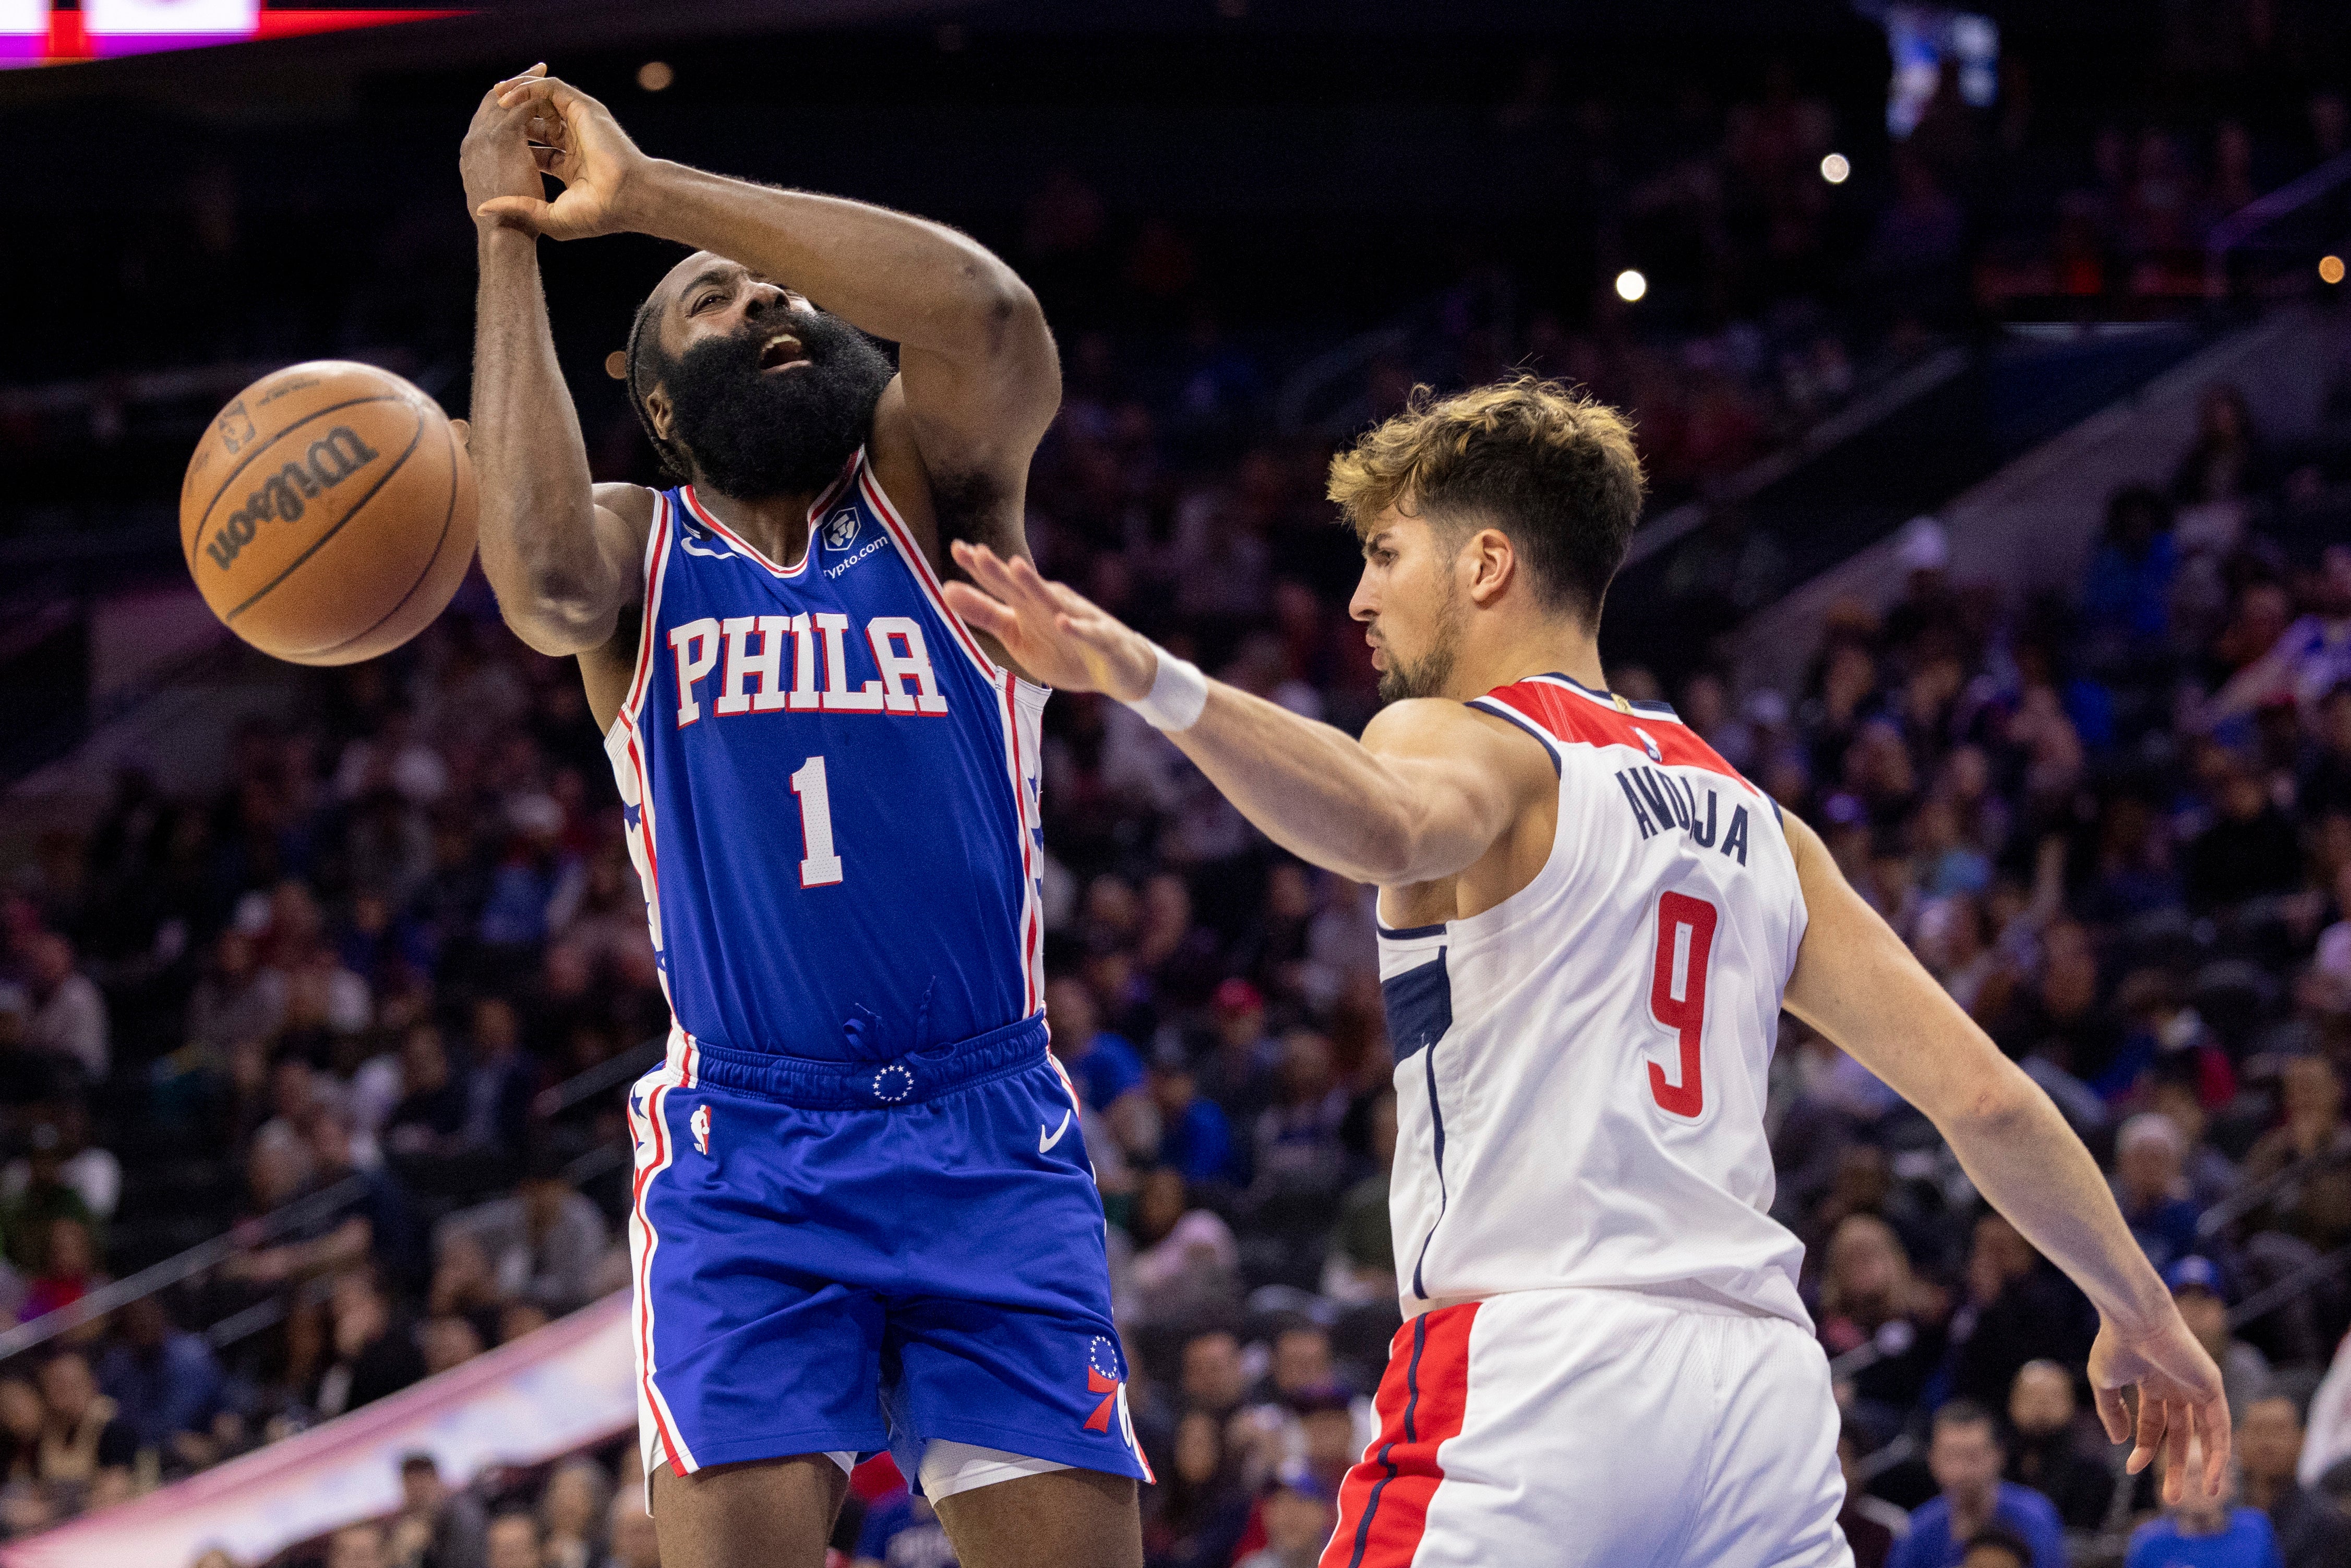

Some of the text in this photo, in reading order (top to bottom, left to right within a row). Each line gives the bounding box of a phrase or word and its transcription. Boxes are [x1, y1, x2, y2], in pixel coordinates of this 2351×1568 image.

[207, 425, 379, 570] Wilson
[823, 536, 889, 579] rypto.com
[667, 612, 949, 730] PHILA
[789, 756, 843, 889] 1
[1615, 765, 1748, 867] AVDIJA
[1647, 890, 1718, 1118] 9
